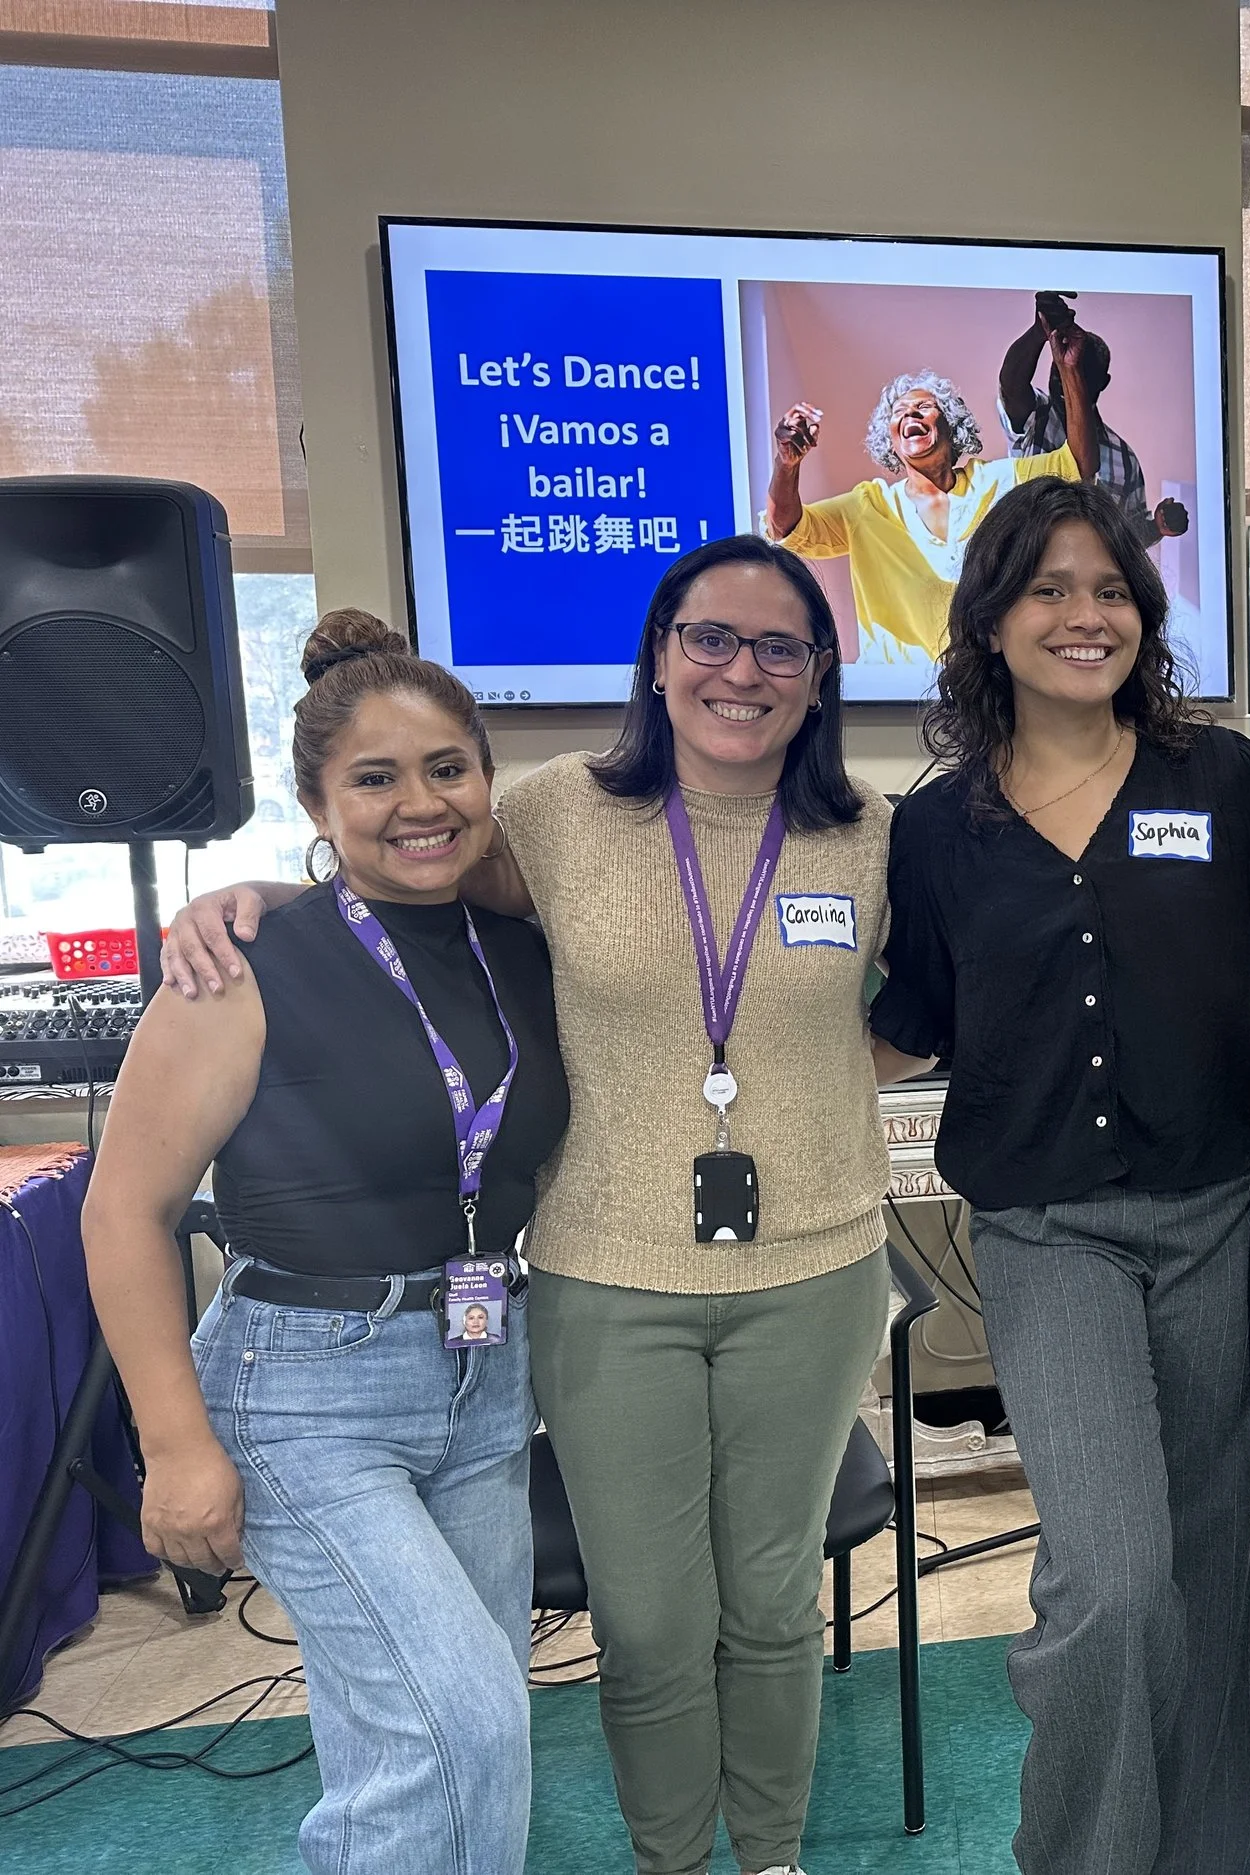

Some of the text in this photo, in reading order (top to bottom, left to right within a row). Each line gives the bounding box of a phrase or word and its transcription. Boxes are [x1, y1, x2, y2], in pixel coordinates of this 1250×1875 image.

[459, 352, 700, 390] Let’s Dance!
[500, 414, 670, 448] ¡Vamos a
[528, 466, 646, 498] bailar!
[1135, 822, 1200, 846] Sophia
[786, 903, 846, 928] Carolina
